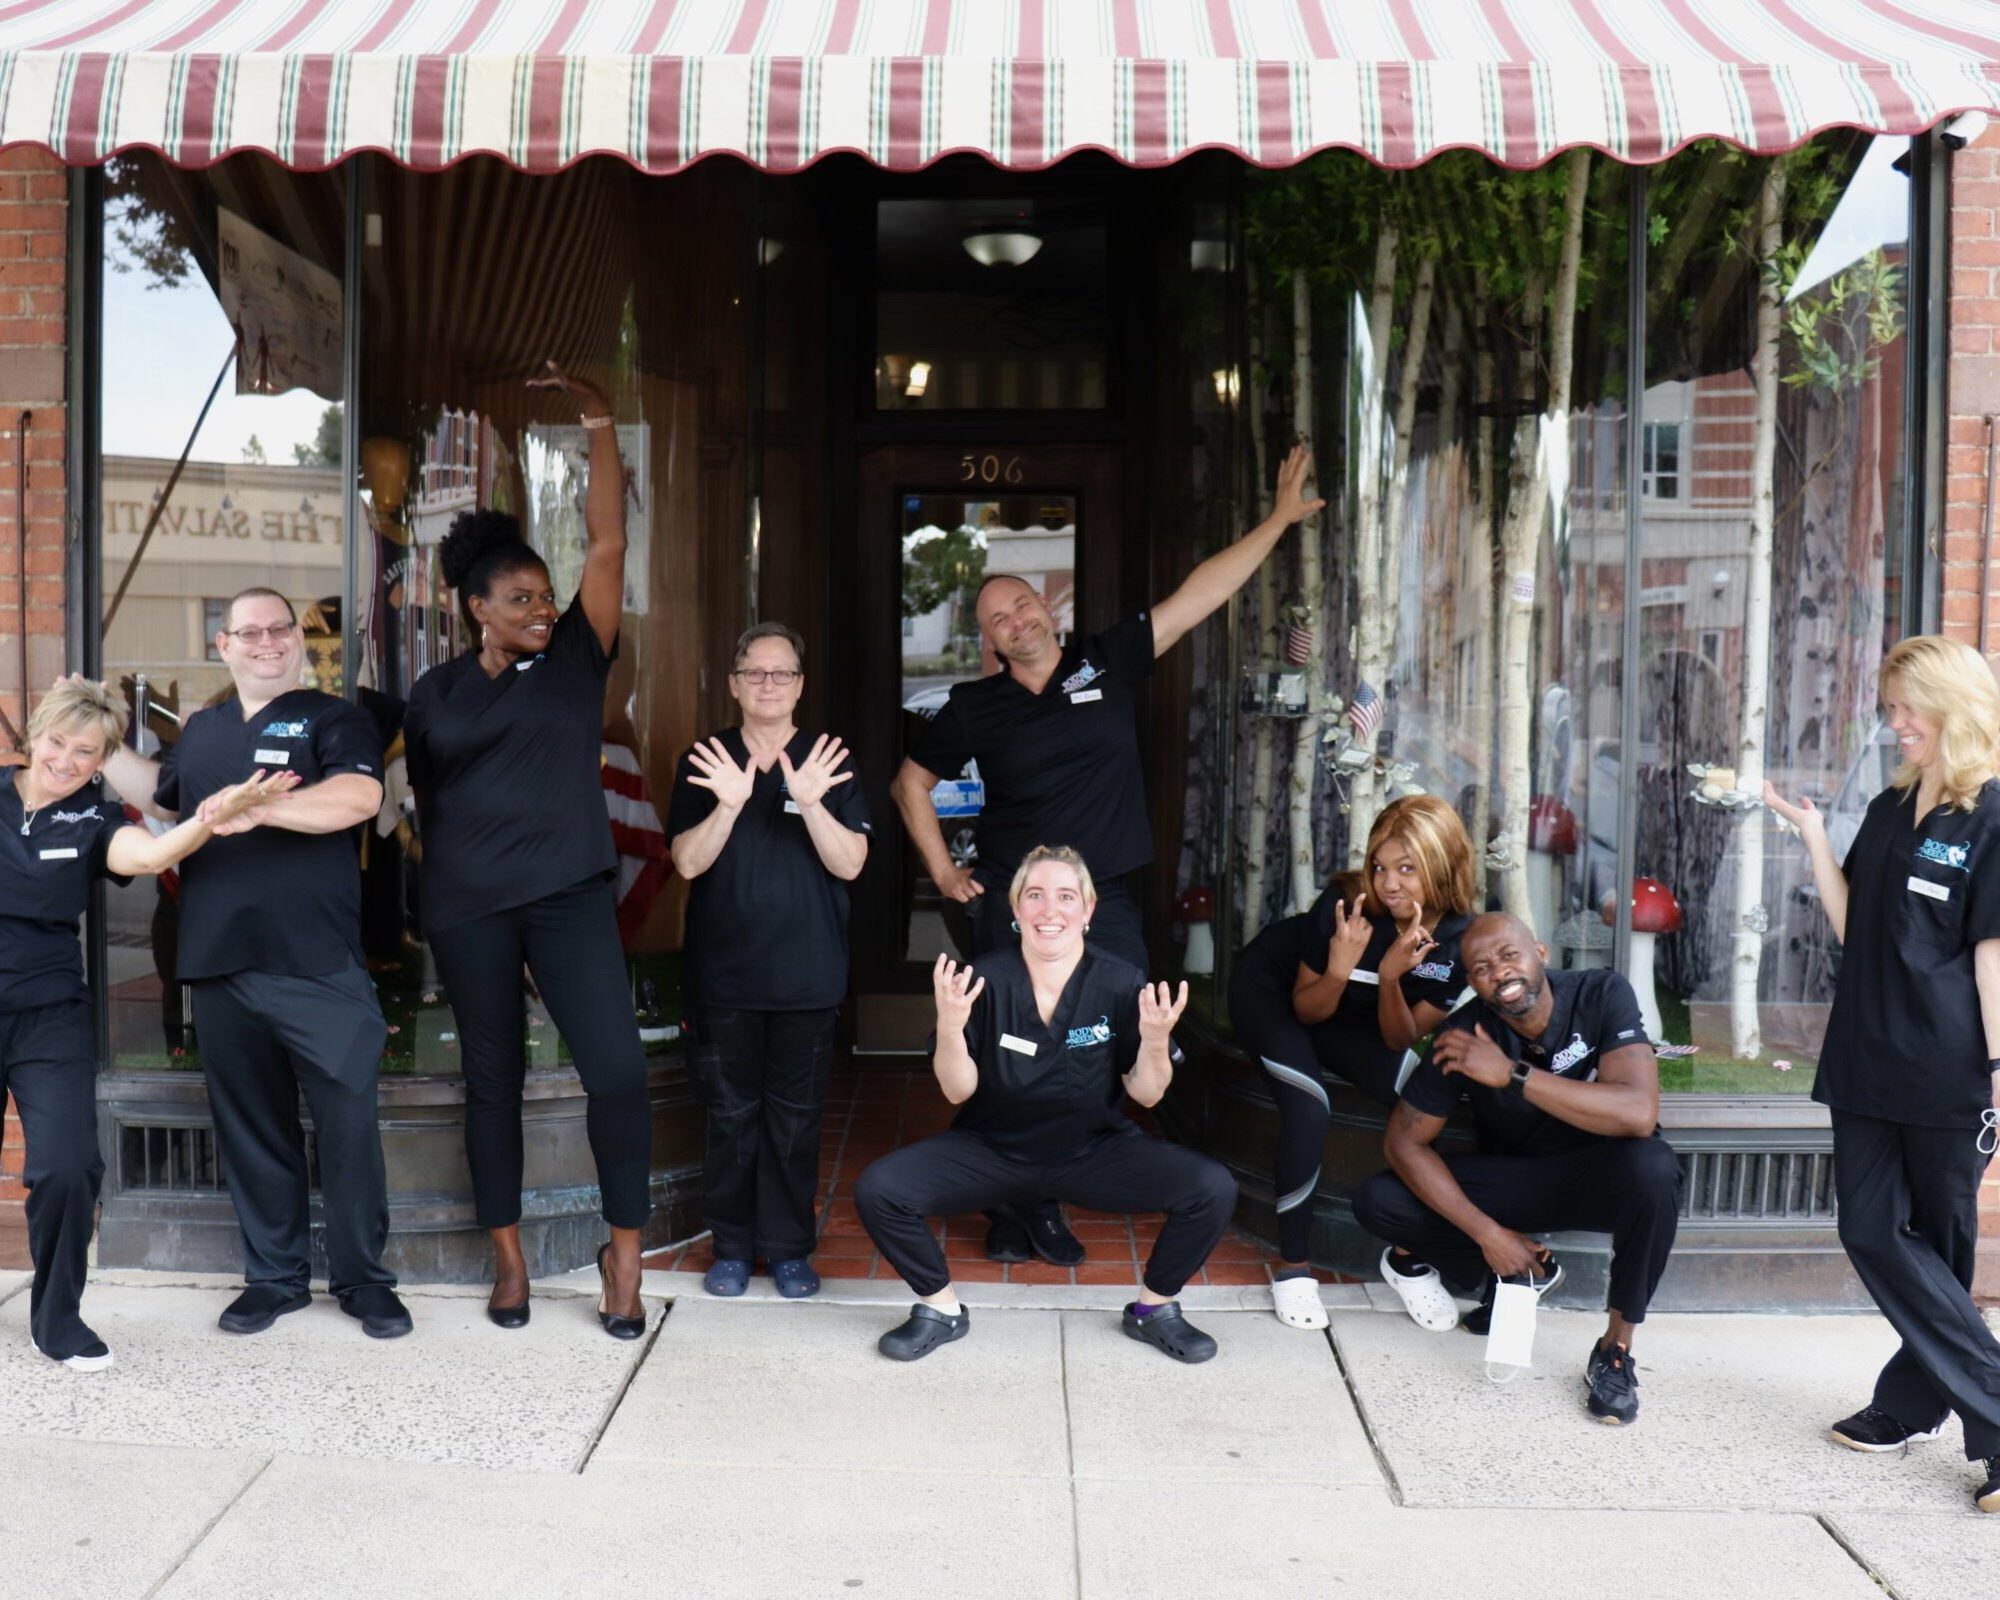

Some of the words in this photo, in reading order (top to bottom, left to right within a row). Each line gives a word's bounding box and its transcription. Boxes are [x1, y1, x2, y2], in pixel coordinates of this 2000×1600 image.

[961, 455, 1023, 483] 506
[933, 791, 967, 808] COME
[968, 791, 981, 806] IN
[1924, 838, 1949, 852] BODY
[1068, 1026, 1094, 1039] BODY
[1070, 1034, 1096, 1044] NEEDS
